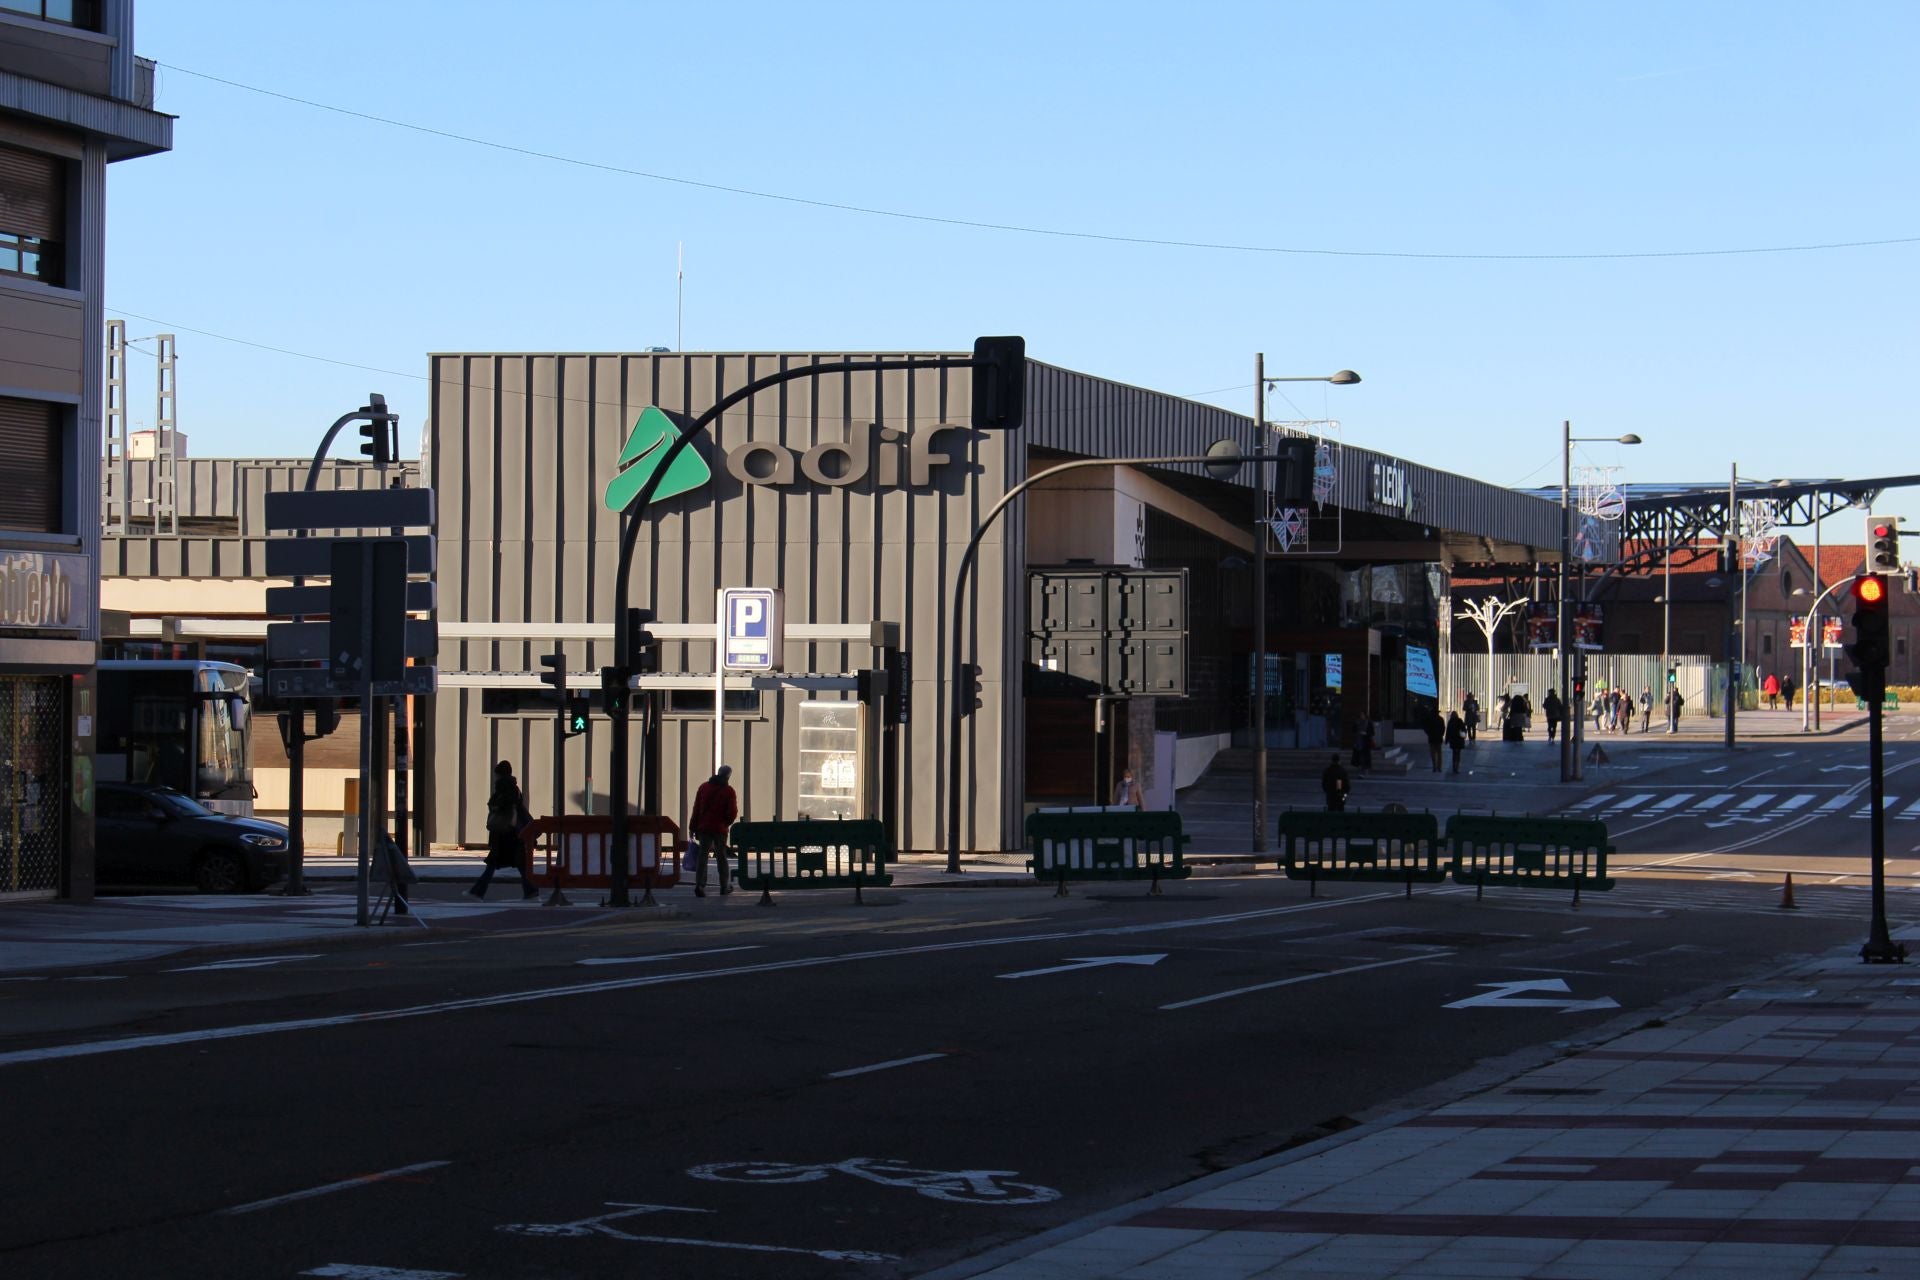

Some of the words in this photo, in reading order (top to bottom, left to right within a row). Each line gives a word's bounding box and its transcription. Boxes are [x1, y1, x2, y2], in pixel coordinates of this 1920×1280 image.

[726, 421, 956, 485] adif
[1382, 458, 1405, 508] LEÓN
[736, 599, 762, 636] P
